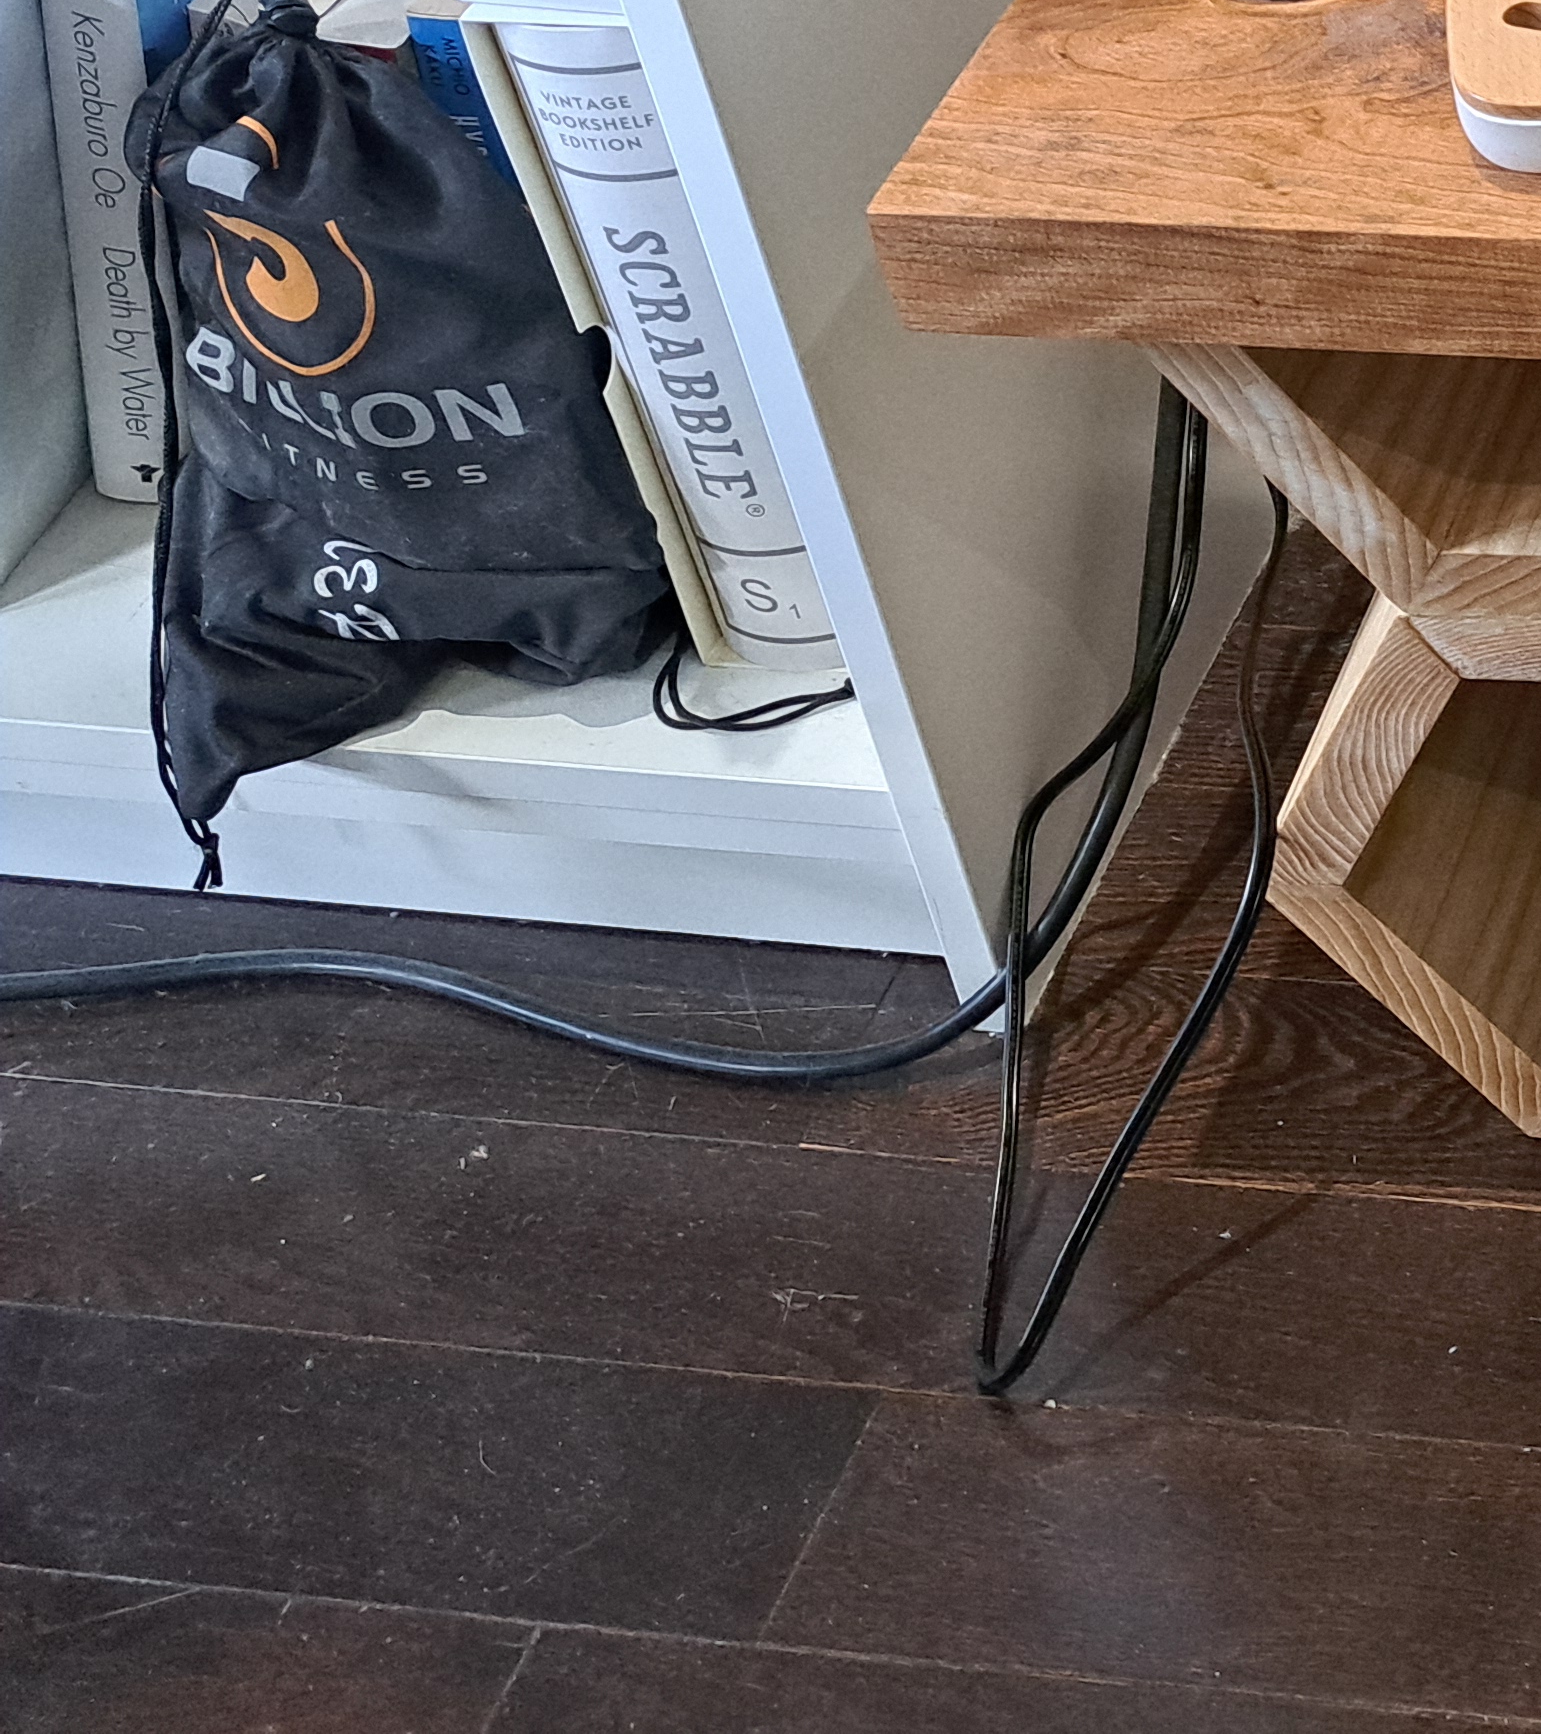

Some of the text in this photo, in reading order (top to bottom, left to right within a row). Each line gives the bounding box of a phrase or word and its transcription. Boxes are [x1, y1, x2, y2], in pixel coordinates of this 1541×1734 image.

[441, 35, 471, 96] MICHIO
[538, 107, 655, 132] BOOKSHELF
[540, 90, 632, 111] VINTAGE
[559, 132, 643, 152] EDITION
[71, 11, 156, 440] Kenzaburo Oe Death by Water
[603, 226, 757, 499] SCRABBLE
[238, 417, 488, 491] ITNESS
[741, 578, 801, 619] S 1
